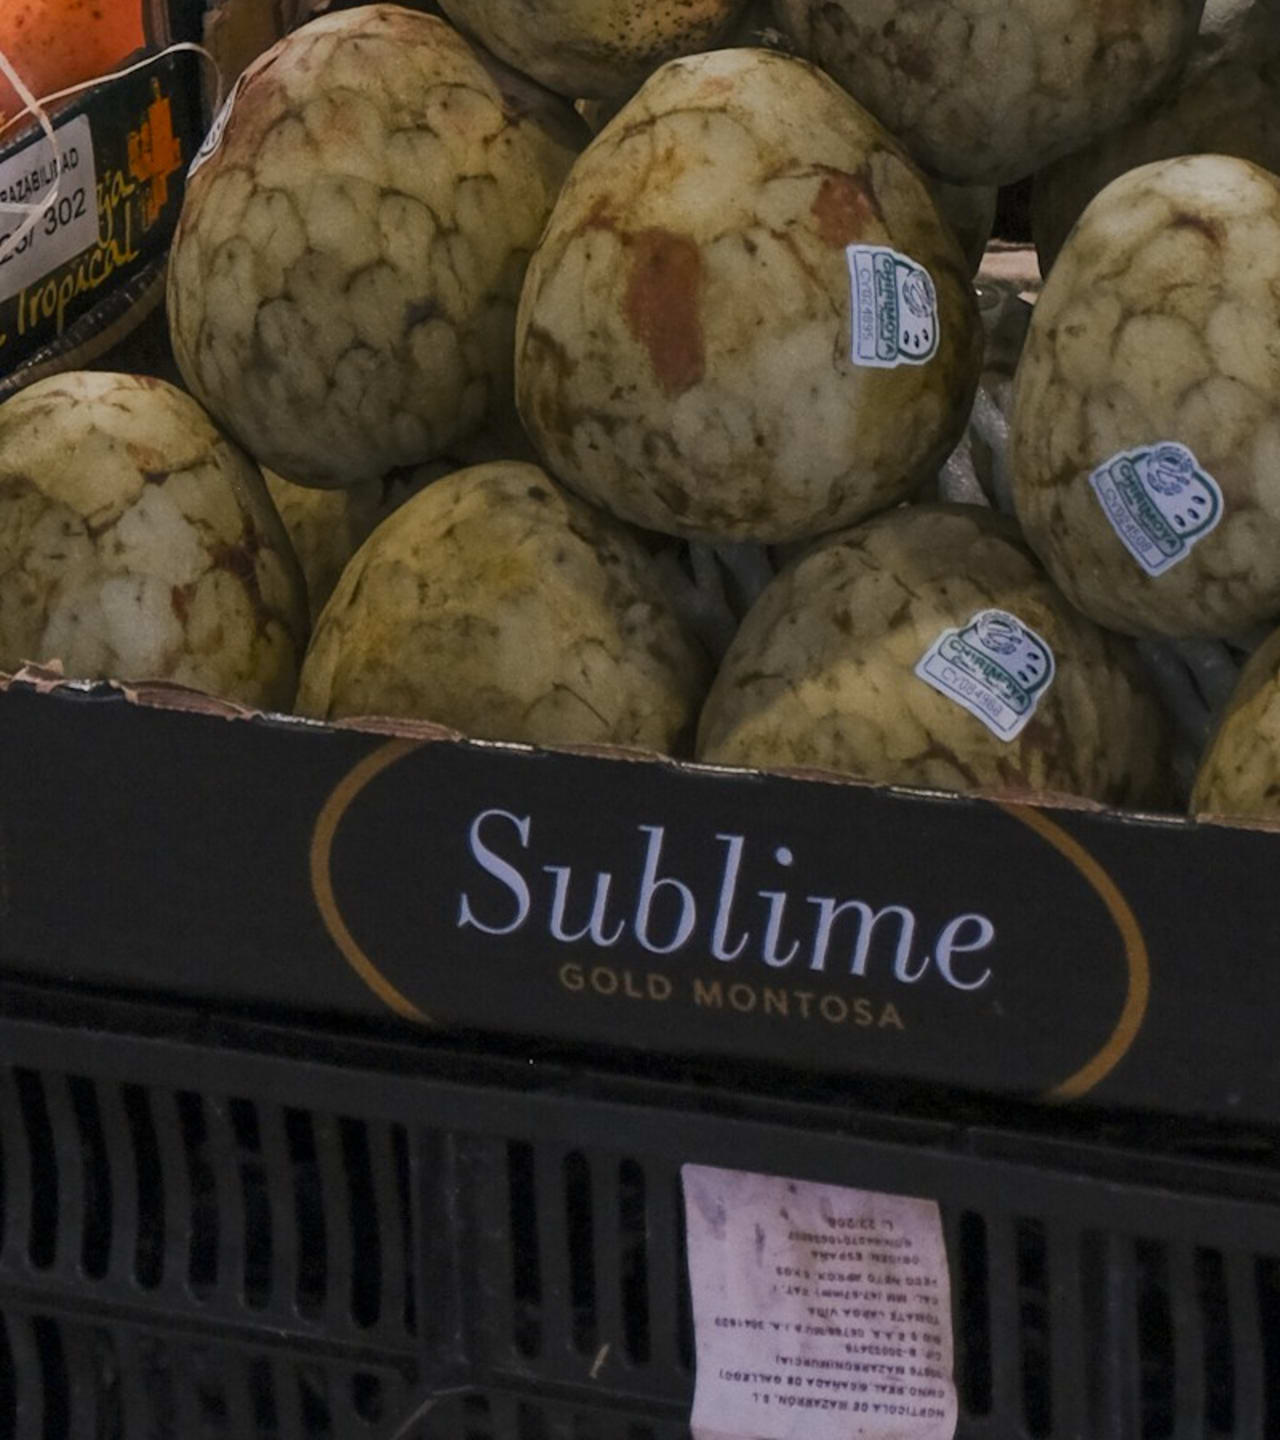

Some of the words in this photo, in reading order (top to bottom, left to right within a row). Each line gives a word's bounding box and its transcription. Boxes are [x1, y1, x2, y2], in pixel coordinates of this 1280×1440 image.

[881, 257, 897, 357] CHIRIMOYA
[1119, 463, 1177, 550] CHIRIMOYA
[458, 808, 996, 992] Sublime
[560, 961, 674, 1002] GOLD
[692, 978, 906, 1030] MONTOSA
